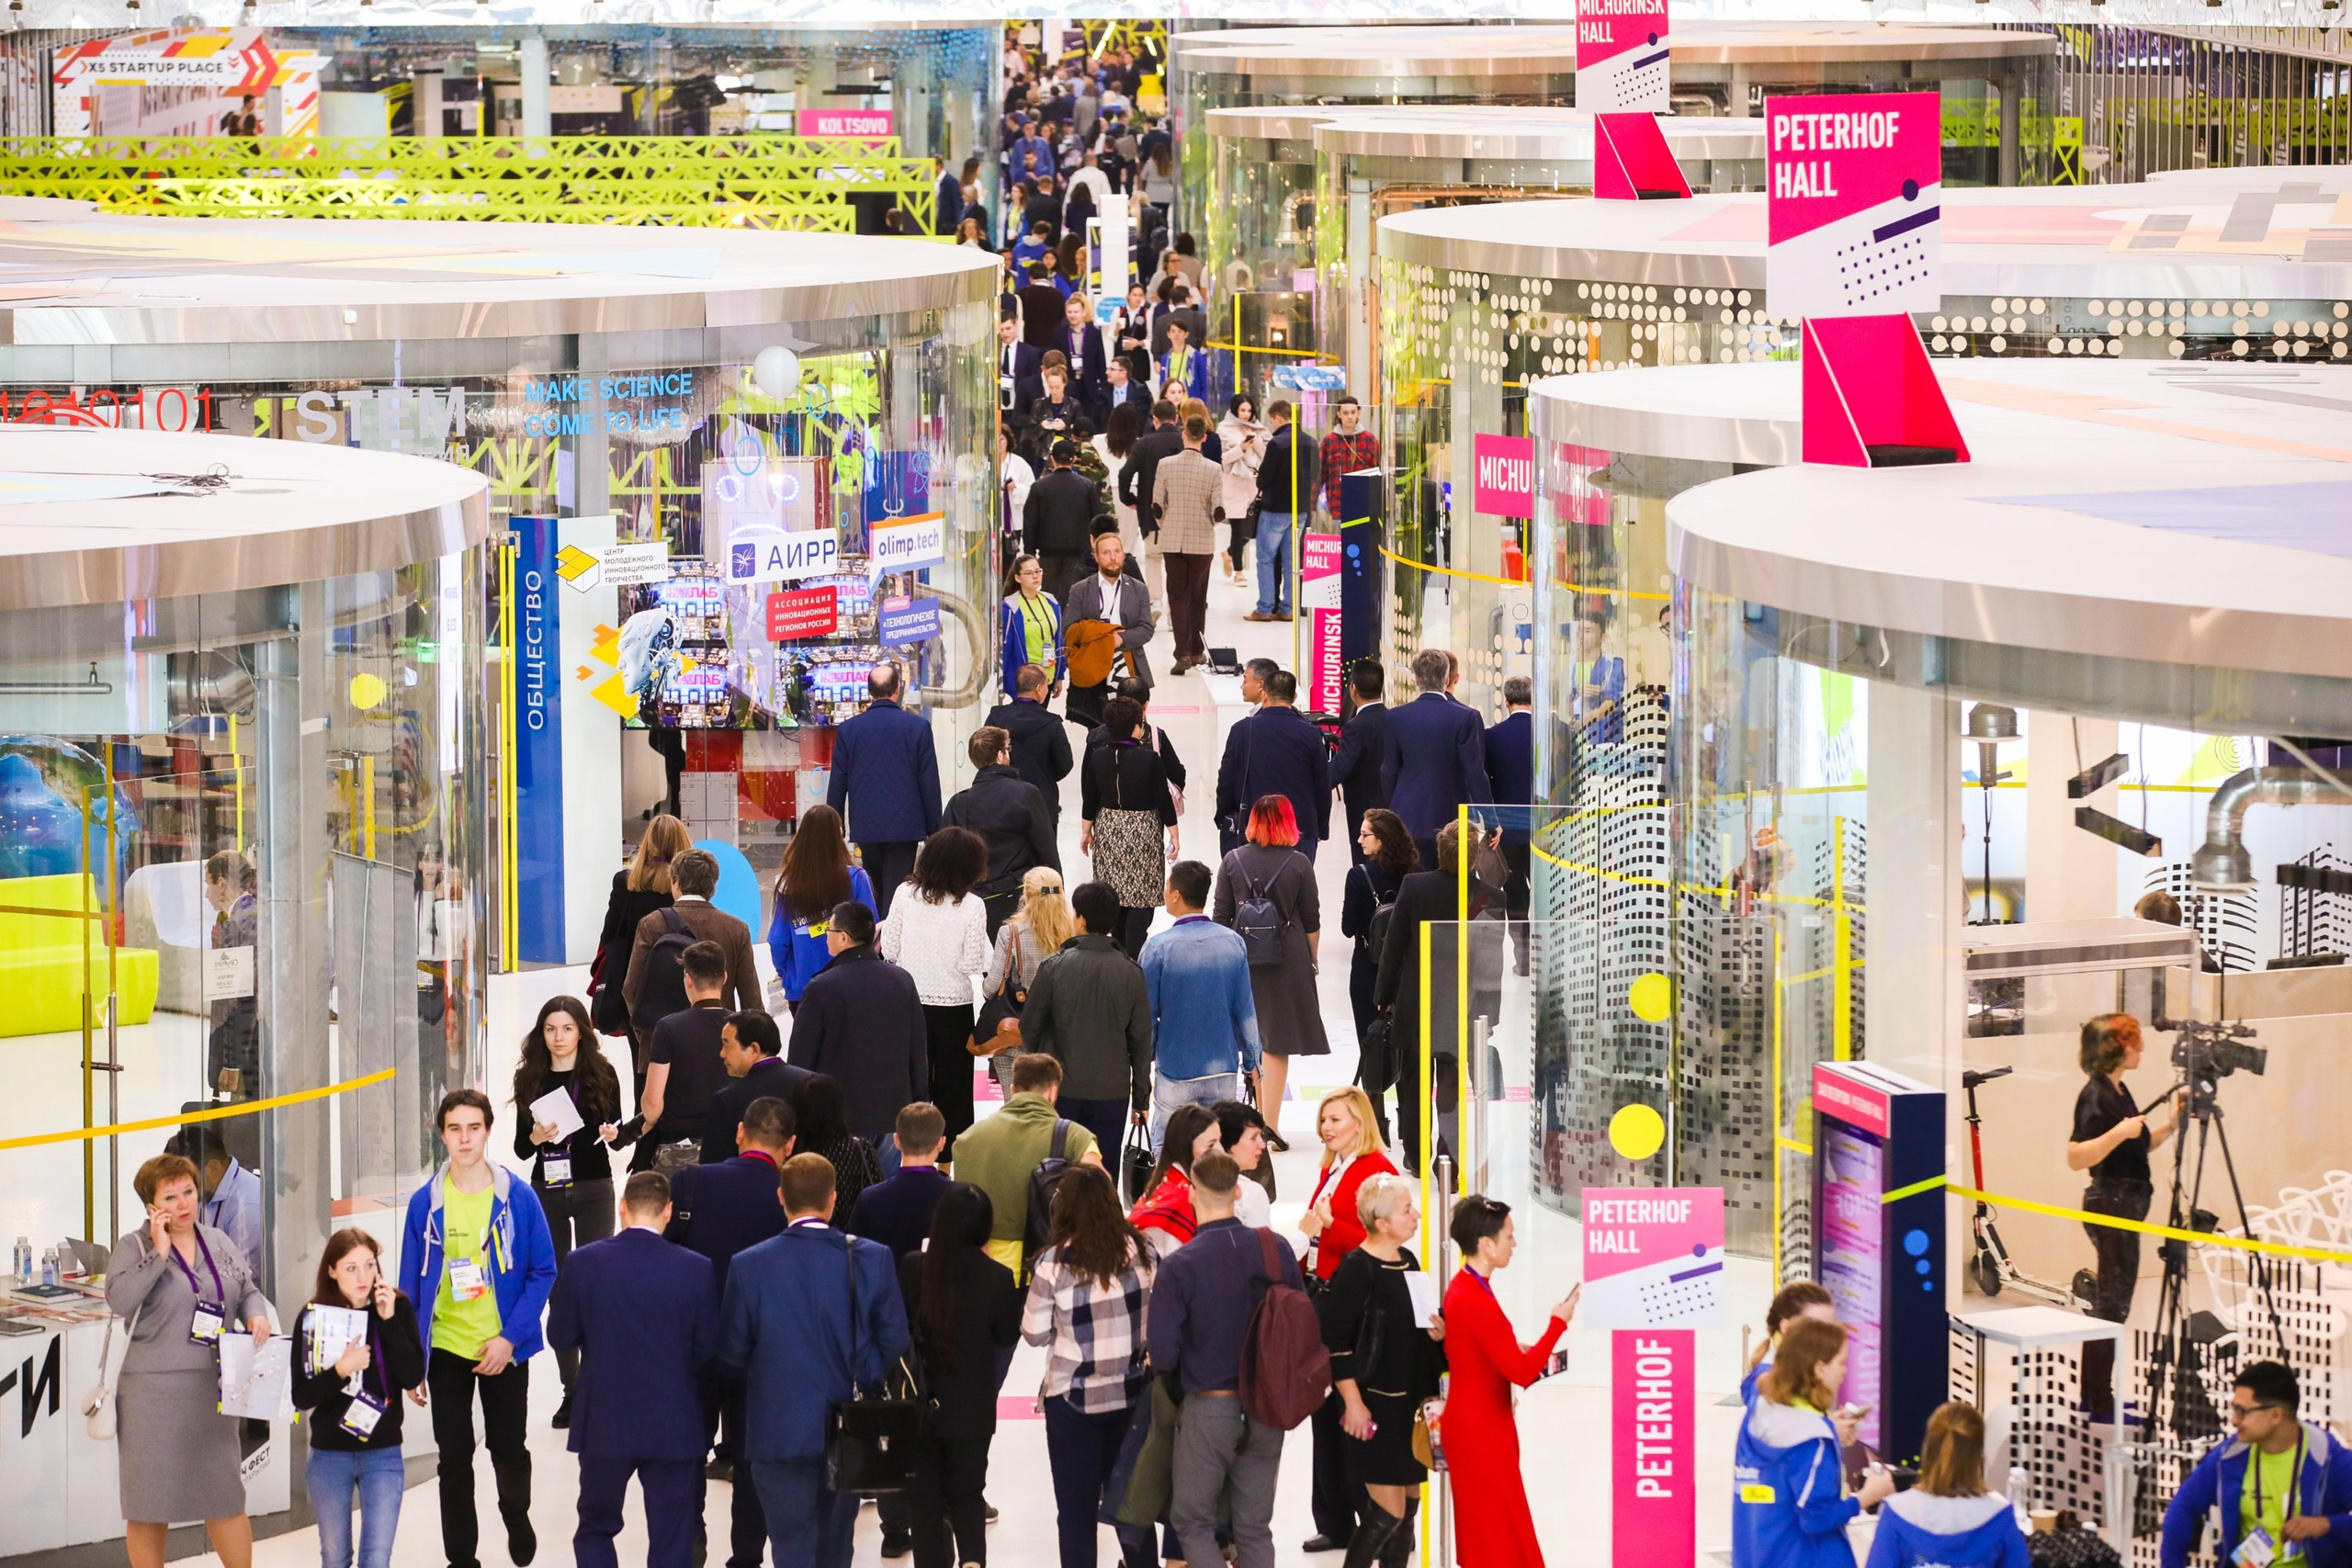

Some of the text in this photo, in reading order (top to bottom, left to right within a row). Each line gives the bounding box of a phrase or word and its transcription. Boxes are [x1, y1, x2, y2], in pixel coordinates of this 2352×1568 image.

[1580, 21, 1614, 43] HALL
[89, 62, 223, 73] X5 STARTUP PLACE
[818, 117, 888, 135] KOLTSOVO
[1774, 111, 1900, 152] PETERHOF
[1775, 161, 1838, 198] HALL
[526, 373, 693, 402] MAKE SCIENCE
[296, 386, 466, 443] STEM
[526, 408, 683, 437] COME TO LIFE
[767, 538, 836, 570] АИРР
[879, 530, 940, 557] olimp.tech
[605, 563, 666, 574] ИННОВАЦИОННОГО
[1306, 555, 1329, 569] HALL
[605, 575, 644, 583] ТВОРЧЕСТВА
[775, 593, 831, 608] АССОЦИАЦИЯ
[775, 606, 831, 621] ИННОВАЦИОННЫХ
[775, 619, 831, 633] РЕГИОНОВ РОССИИ
[526, 570, 546, 730] ОБЩЕСТВО
[1323, 613, 1341, 719] MICHURINSK
[1589, 1200, 1691, 1224] PETERHOF
[1589, 1230, 1641, 1254] HALL
[1635, 1338, 1673, 1497] PETERHOF
[248, 1446, 271, 1471] ФЕСТ
